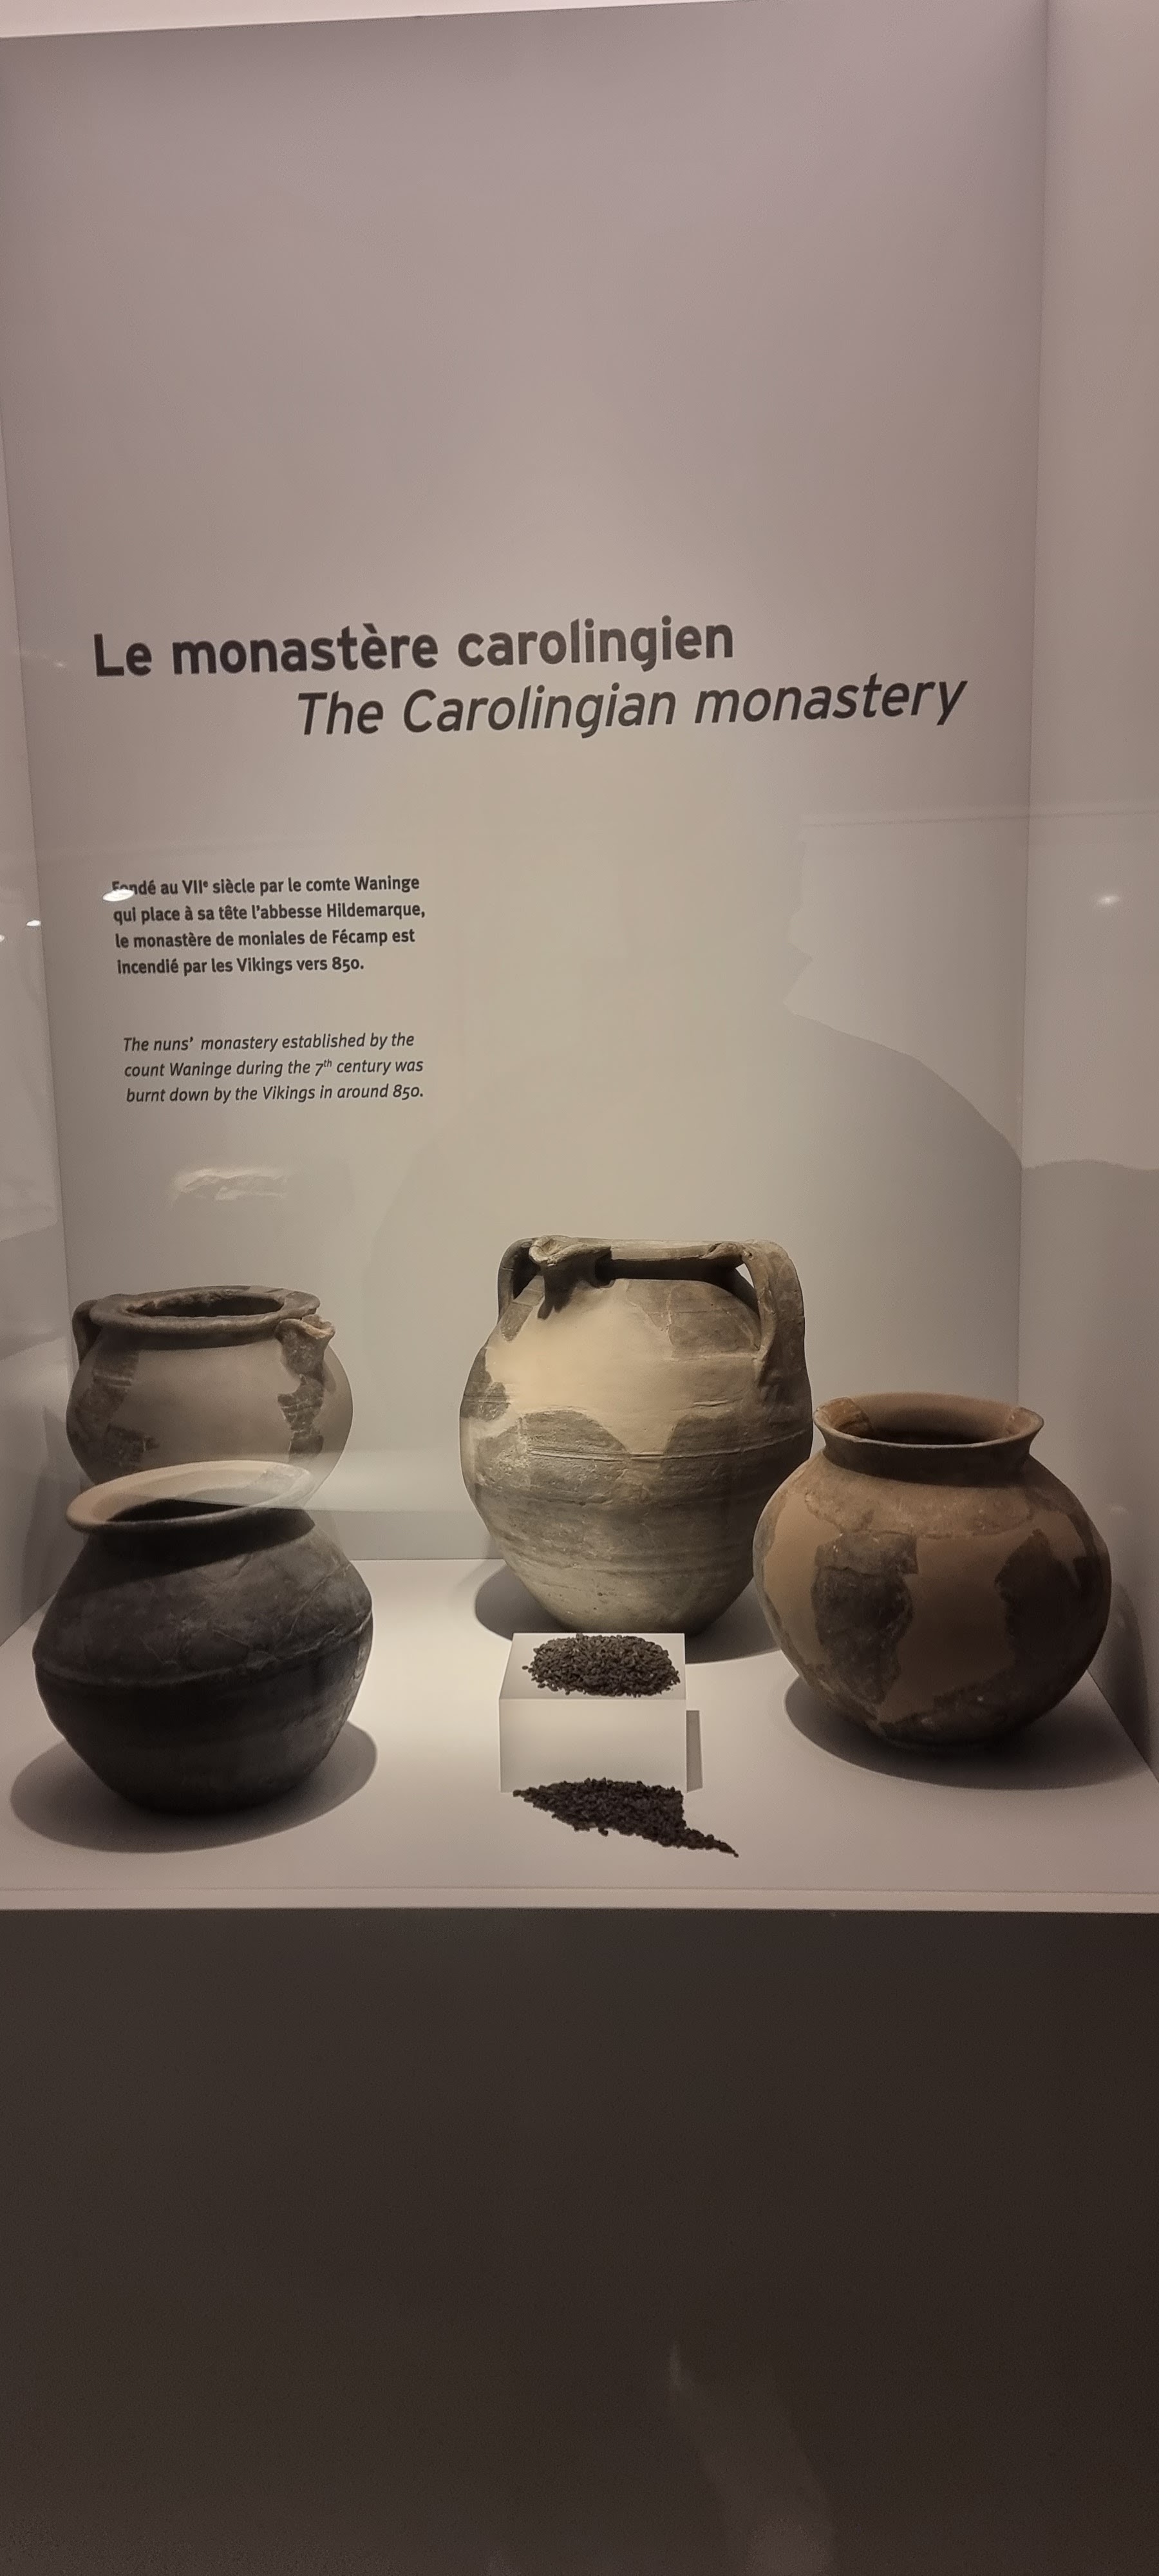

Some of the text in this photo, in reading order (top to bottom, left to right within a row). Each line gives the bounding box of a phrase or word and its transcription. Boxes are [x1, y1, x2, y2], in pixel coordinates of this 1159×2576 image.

[93, 615, 733, 677] Le monastère carolingien
[297, 672, 968, 739] The Carolingian monastery
[160, 883, 179, 895] au
[212, 878, 256, 895] siècle
[259, 880, 285, 896] par
[287, 876, 302, 893] le
[305, 877, 351, 892] comte
[353, 875, 420, 893] Waninge
[113, 902, 426, 926] qui place à sa tête l’abbesse Hildemarque,
[115, 928, 416, 949] le monastère de moniales de Fécamp est
[117, 956, 364, 977] incendié par les Vikings vers 850.
[123, 1031, 415, 1053] The nuns’ monastery established by the
[124, 1058, 424, 1079] count Waninge during the 7th century was
[126, 1083, 424, 1104] burnt down by the Vikings in around 850.
